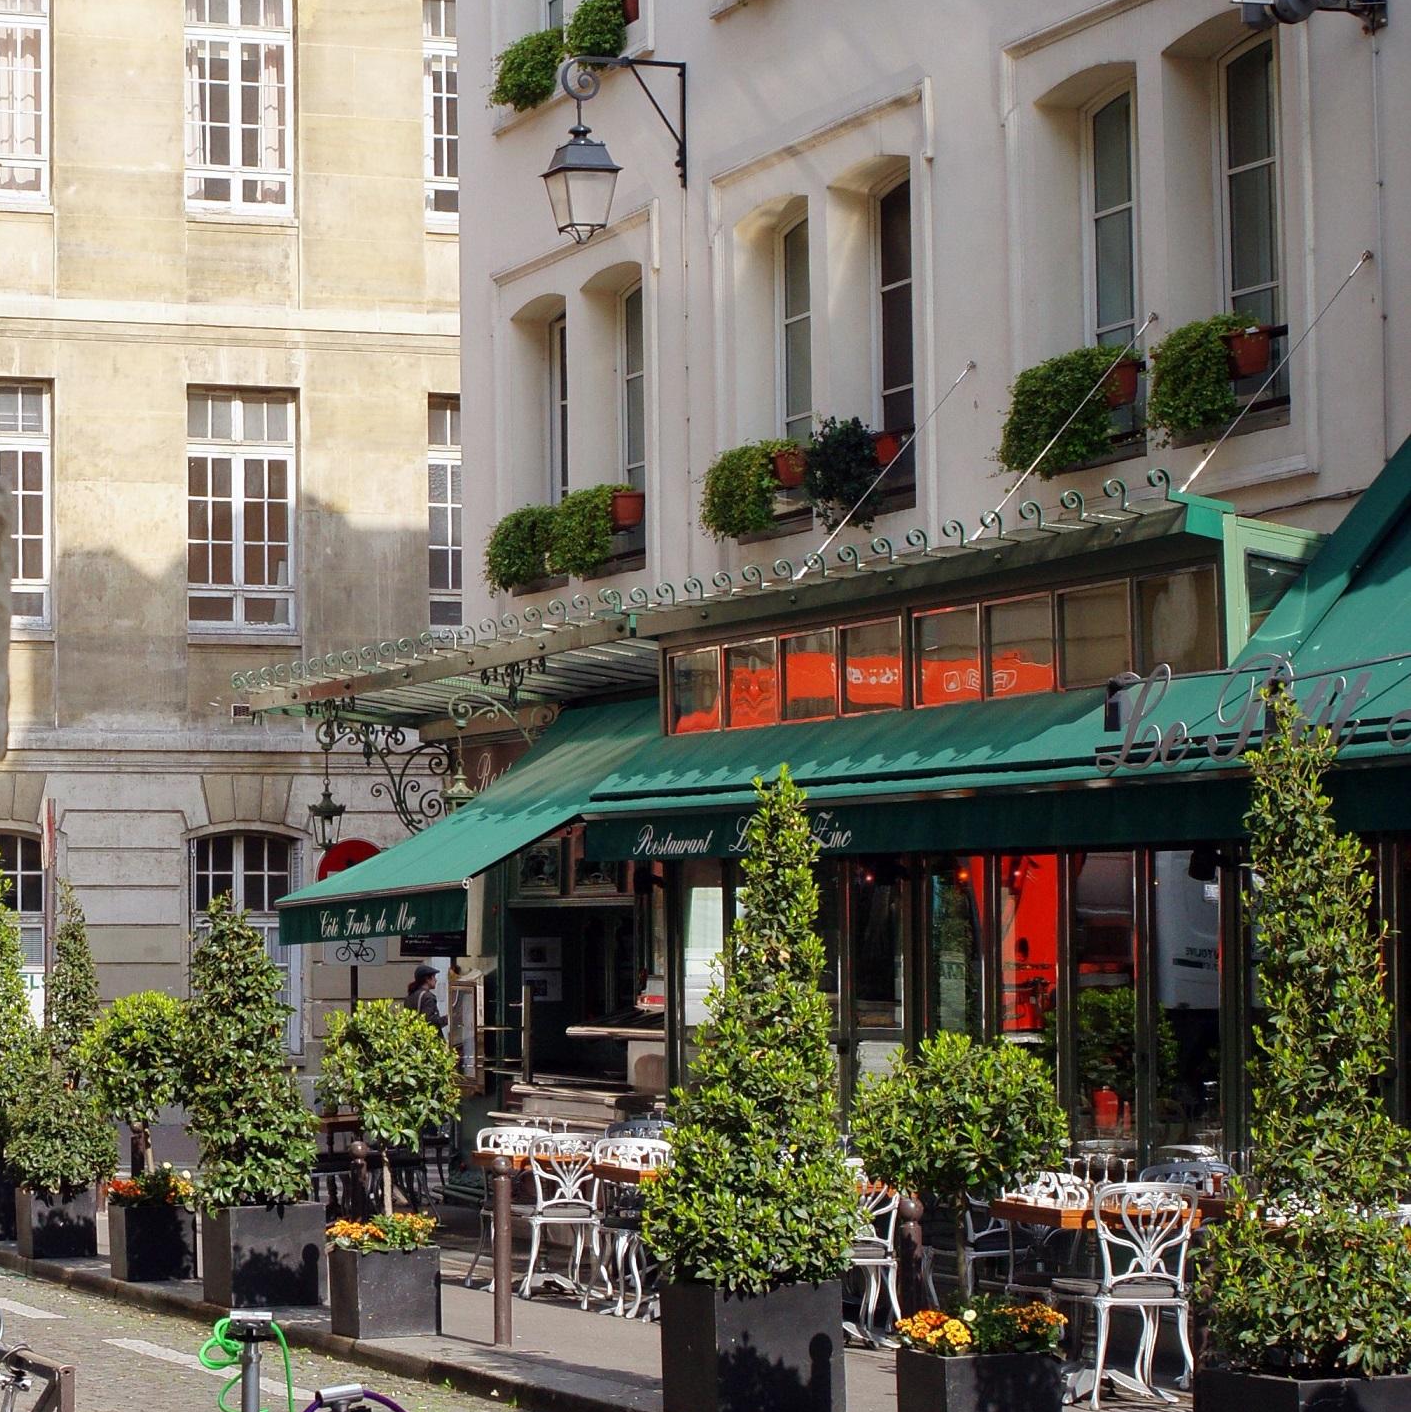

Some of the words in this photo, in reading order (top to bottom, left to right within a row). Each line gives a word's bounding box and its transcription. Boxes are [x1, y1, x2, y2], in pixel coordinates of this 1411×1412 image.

[1096, 663, 1193, 773] Le
[633, 824, 713, 856] Restaurant
[809, 811, 852, 850] Zinc
[343, 908, 371, 936] Fruits
[375, 908, 387, 933] de
[390, 901, 417, 932] Mer
